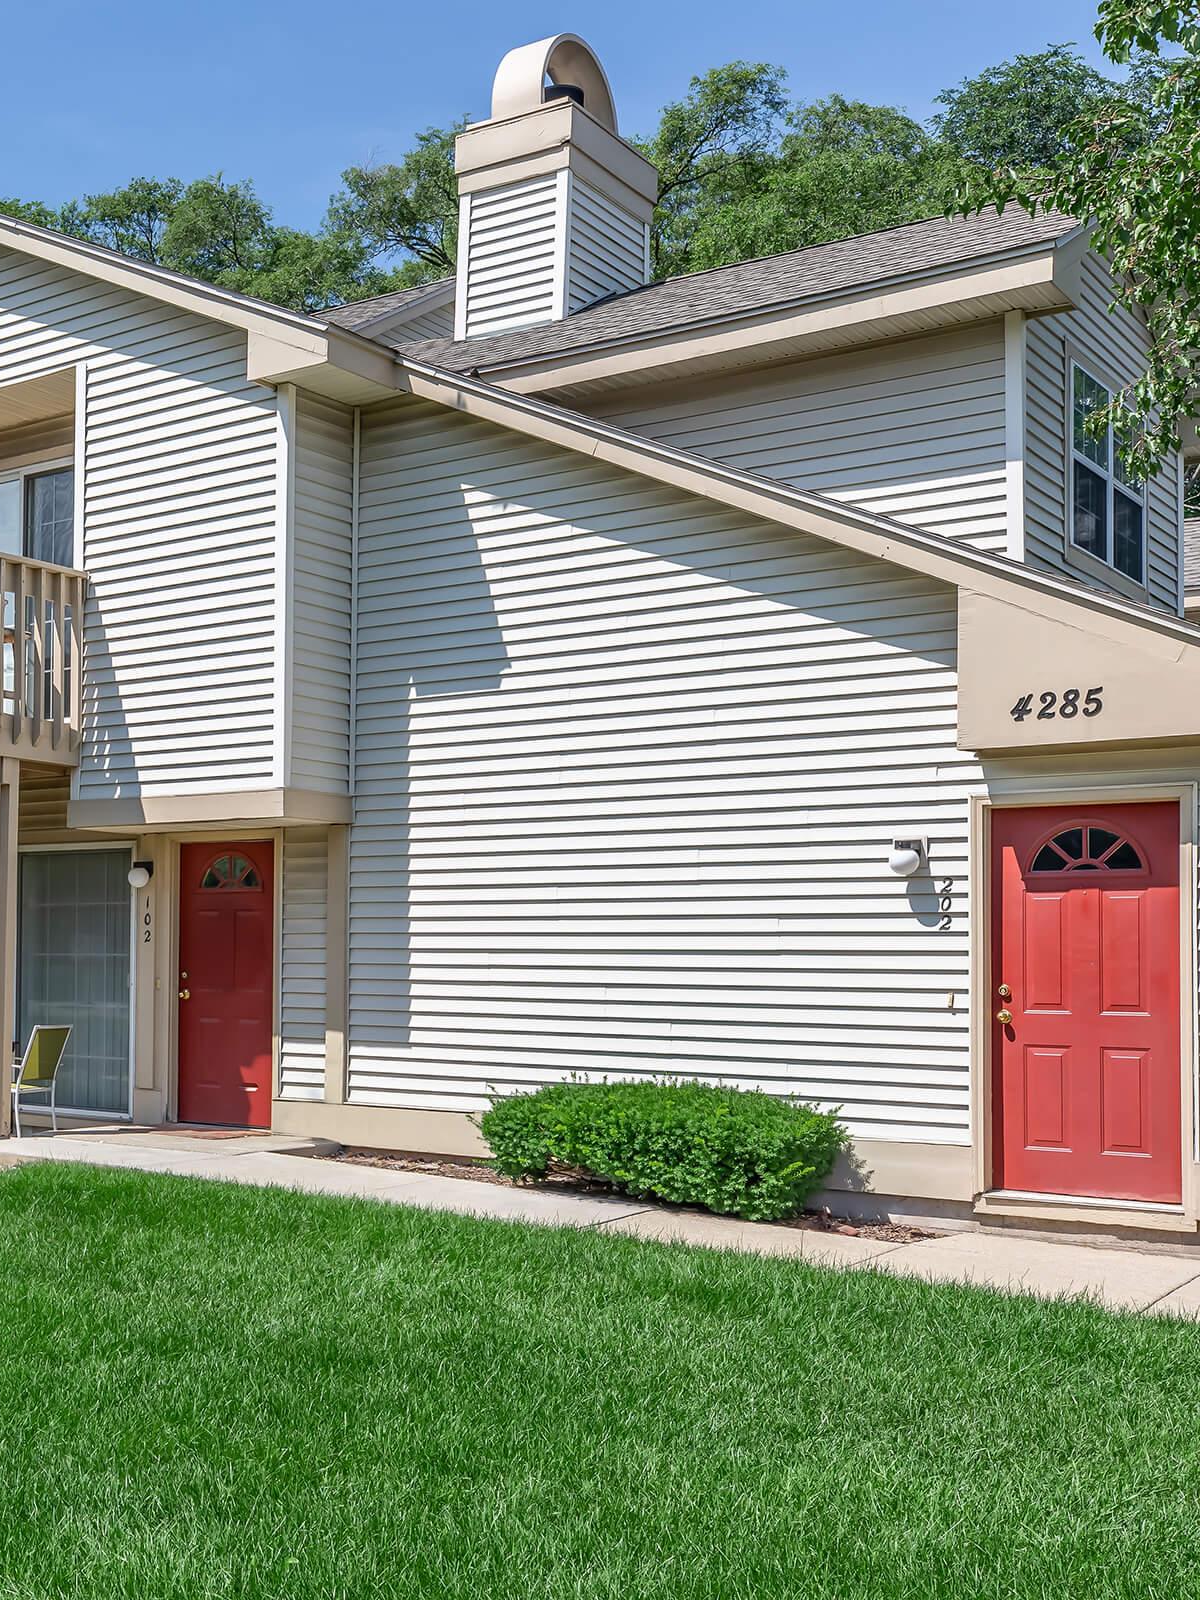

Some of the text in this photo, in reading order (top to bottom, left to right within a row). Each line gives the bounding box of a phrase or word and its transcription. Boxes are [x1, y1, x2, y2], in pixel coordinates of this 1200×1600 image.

[1010, 686, 1103, 722] 4285
[143, 896, 152, 943] 102
[939, 877, 953, 930] 202
